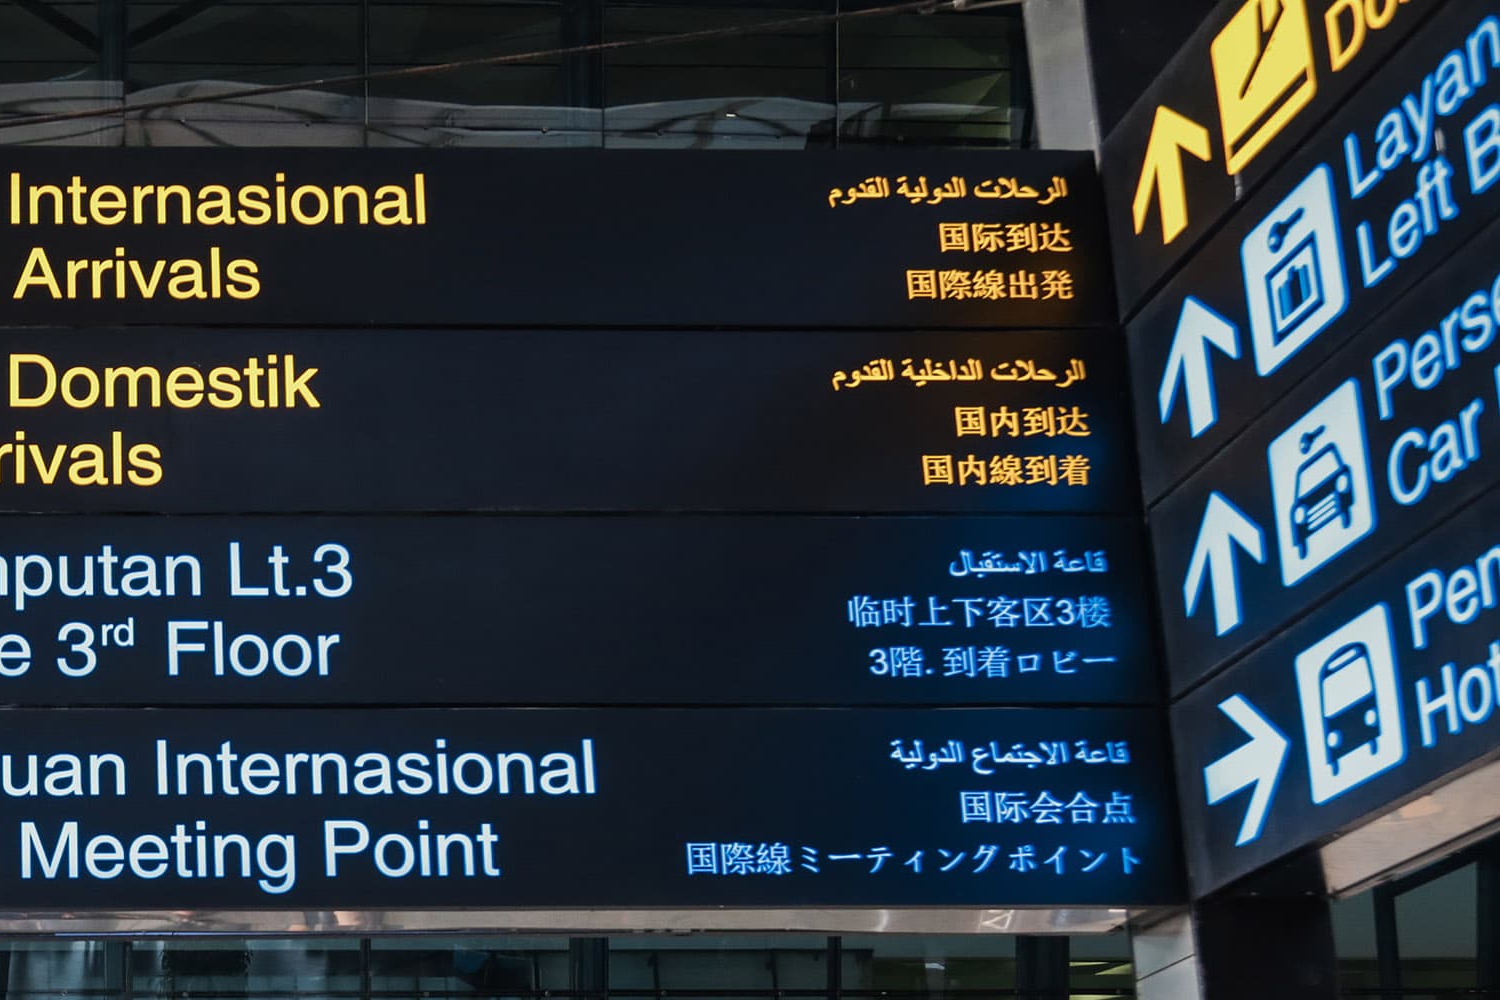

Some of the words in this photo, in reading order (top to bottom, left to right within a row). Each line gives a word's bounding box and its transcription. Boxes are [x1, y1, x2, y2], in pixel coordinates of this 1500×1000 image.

[1324, 0, 1412, 72] Do
[11, 173, 426, 225] Internasional
[1356, 154, 1459, 288] Left
[939, 223, 1072, 253] 国际到达
[13, 247, 260, 299] Arrivals
[906, 270, 1073, 300] 国際線出発
[10, 354, 320, 408] Domestik
[955, 406, 1090, 437] 国内到达
[922, 455, 1090, 485] 国内線到着
[1387, 397, 1484, 505] Car
[230, 542, 352, 598] Lt.3
[848, 595, 1112, 628] 临时上下客区3楼
[57, 617, 134, 677] 3rd
[168, 620, 340, 677] Floor
[156, 739, 596, 795] Internasional
[960, 790, 1137, 824] 国际会合点
[21, 820, 296, 894] Meeting
[324, 820, 500, 878] Point
[686, 842, 1140, 875] 国際線ミーティングポイント
